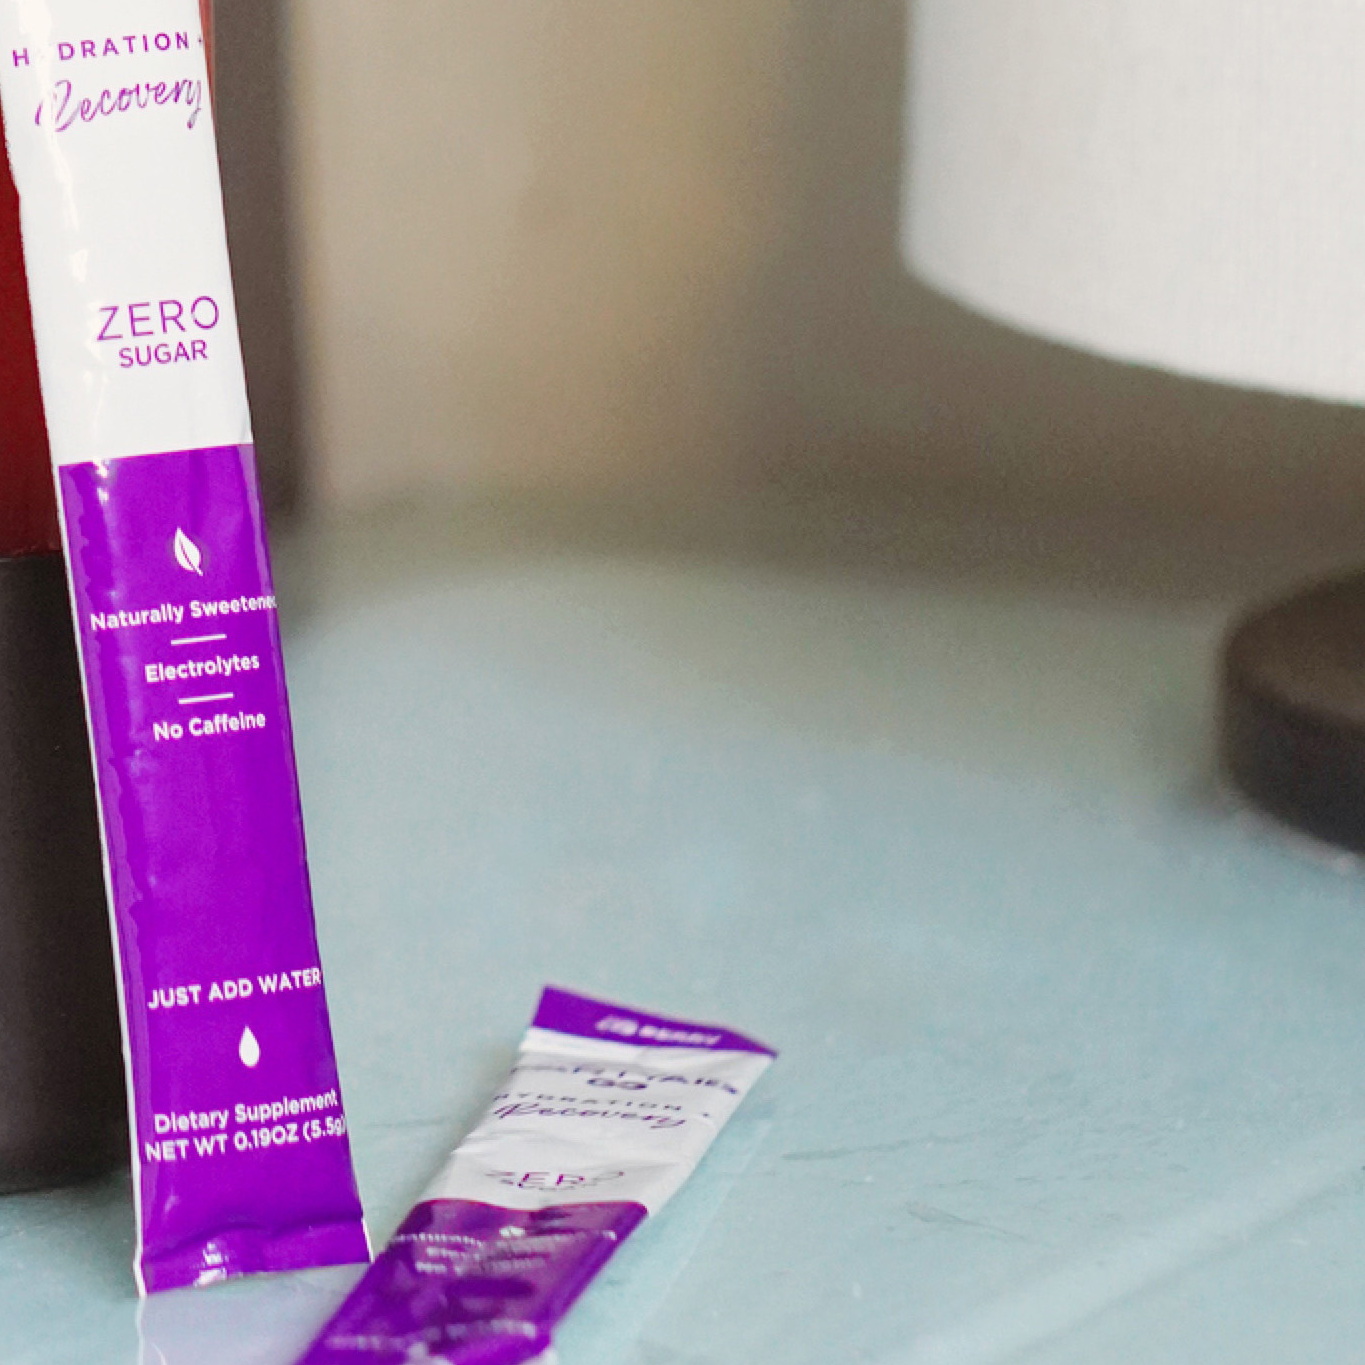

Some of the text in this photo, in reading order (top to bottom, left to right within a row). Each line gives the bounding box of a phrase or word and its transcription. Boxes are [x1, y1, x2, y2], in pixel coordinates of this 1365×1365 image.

[11, 30, 191, 68] HDRATION
[34, 78, 203, 133] Recovery
[96, 295, 221, 341] ZERO
[118, 339, 209, 369] SUGAR
[89, 602, 185, 631] Naturally
[144, 653, 261, 683] Electrolytes
[152, 710, 267, 742] No Caffeine
[147, 966, 323, 1010] JUST ADD WATER
[153, 1088, 340, 1135] Dietary Supplement
[144, 1137, 190, 1164] NET
[193, 1132, 229, 1158] WT
[234, 1122, 300, 1152] 0.19OZ
